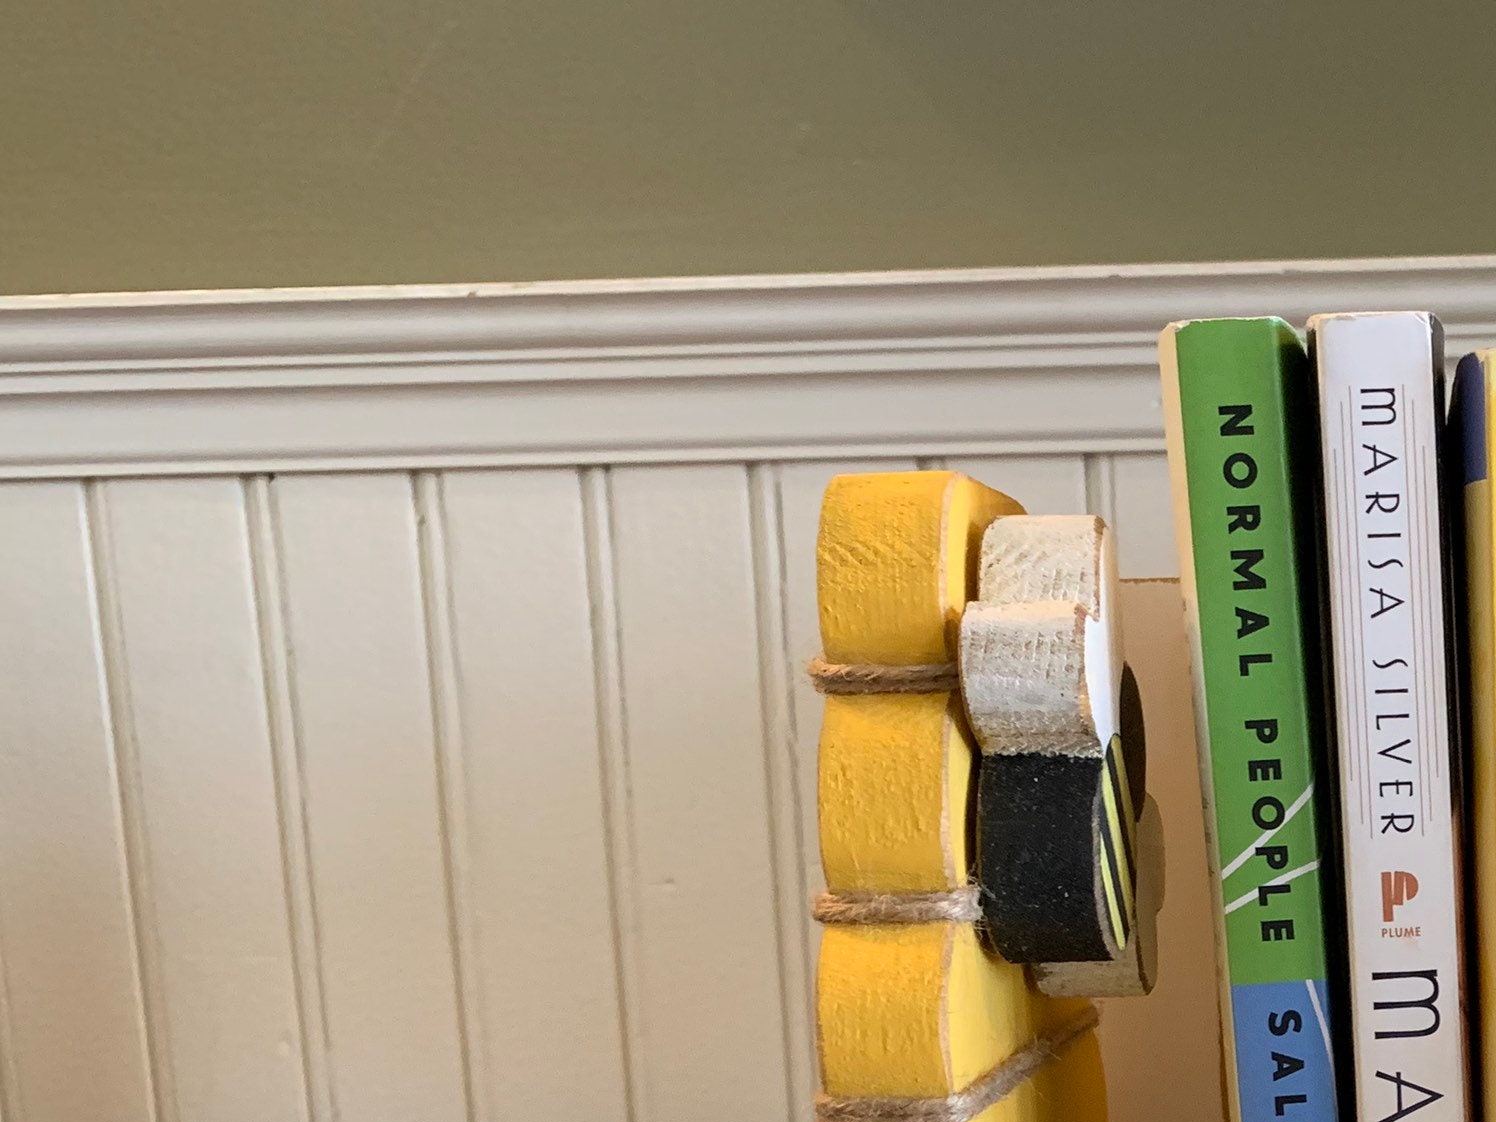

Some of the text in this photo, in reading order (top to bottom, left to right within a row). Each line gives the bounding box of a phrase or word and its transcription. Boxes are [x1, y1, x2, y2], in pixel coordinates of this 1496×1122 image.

[1218, 404, 1295, 943] NORMAL PEOPLE
[1359, 387, 1415, 836] MARISA SILVER
[1381, 926, 1421, 938] PLUME
